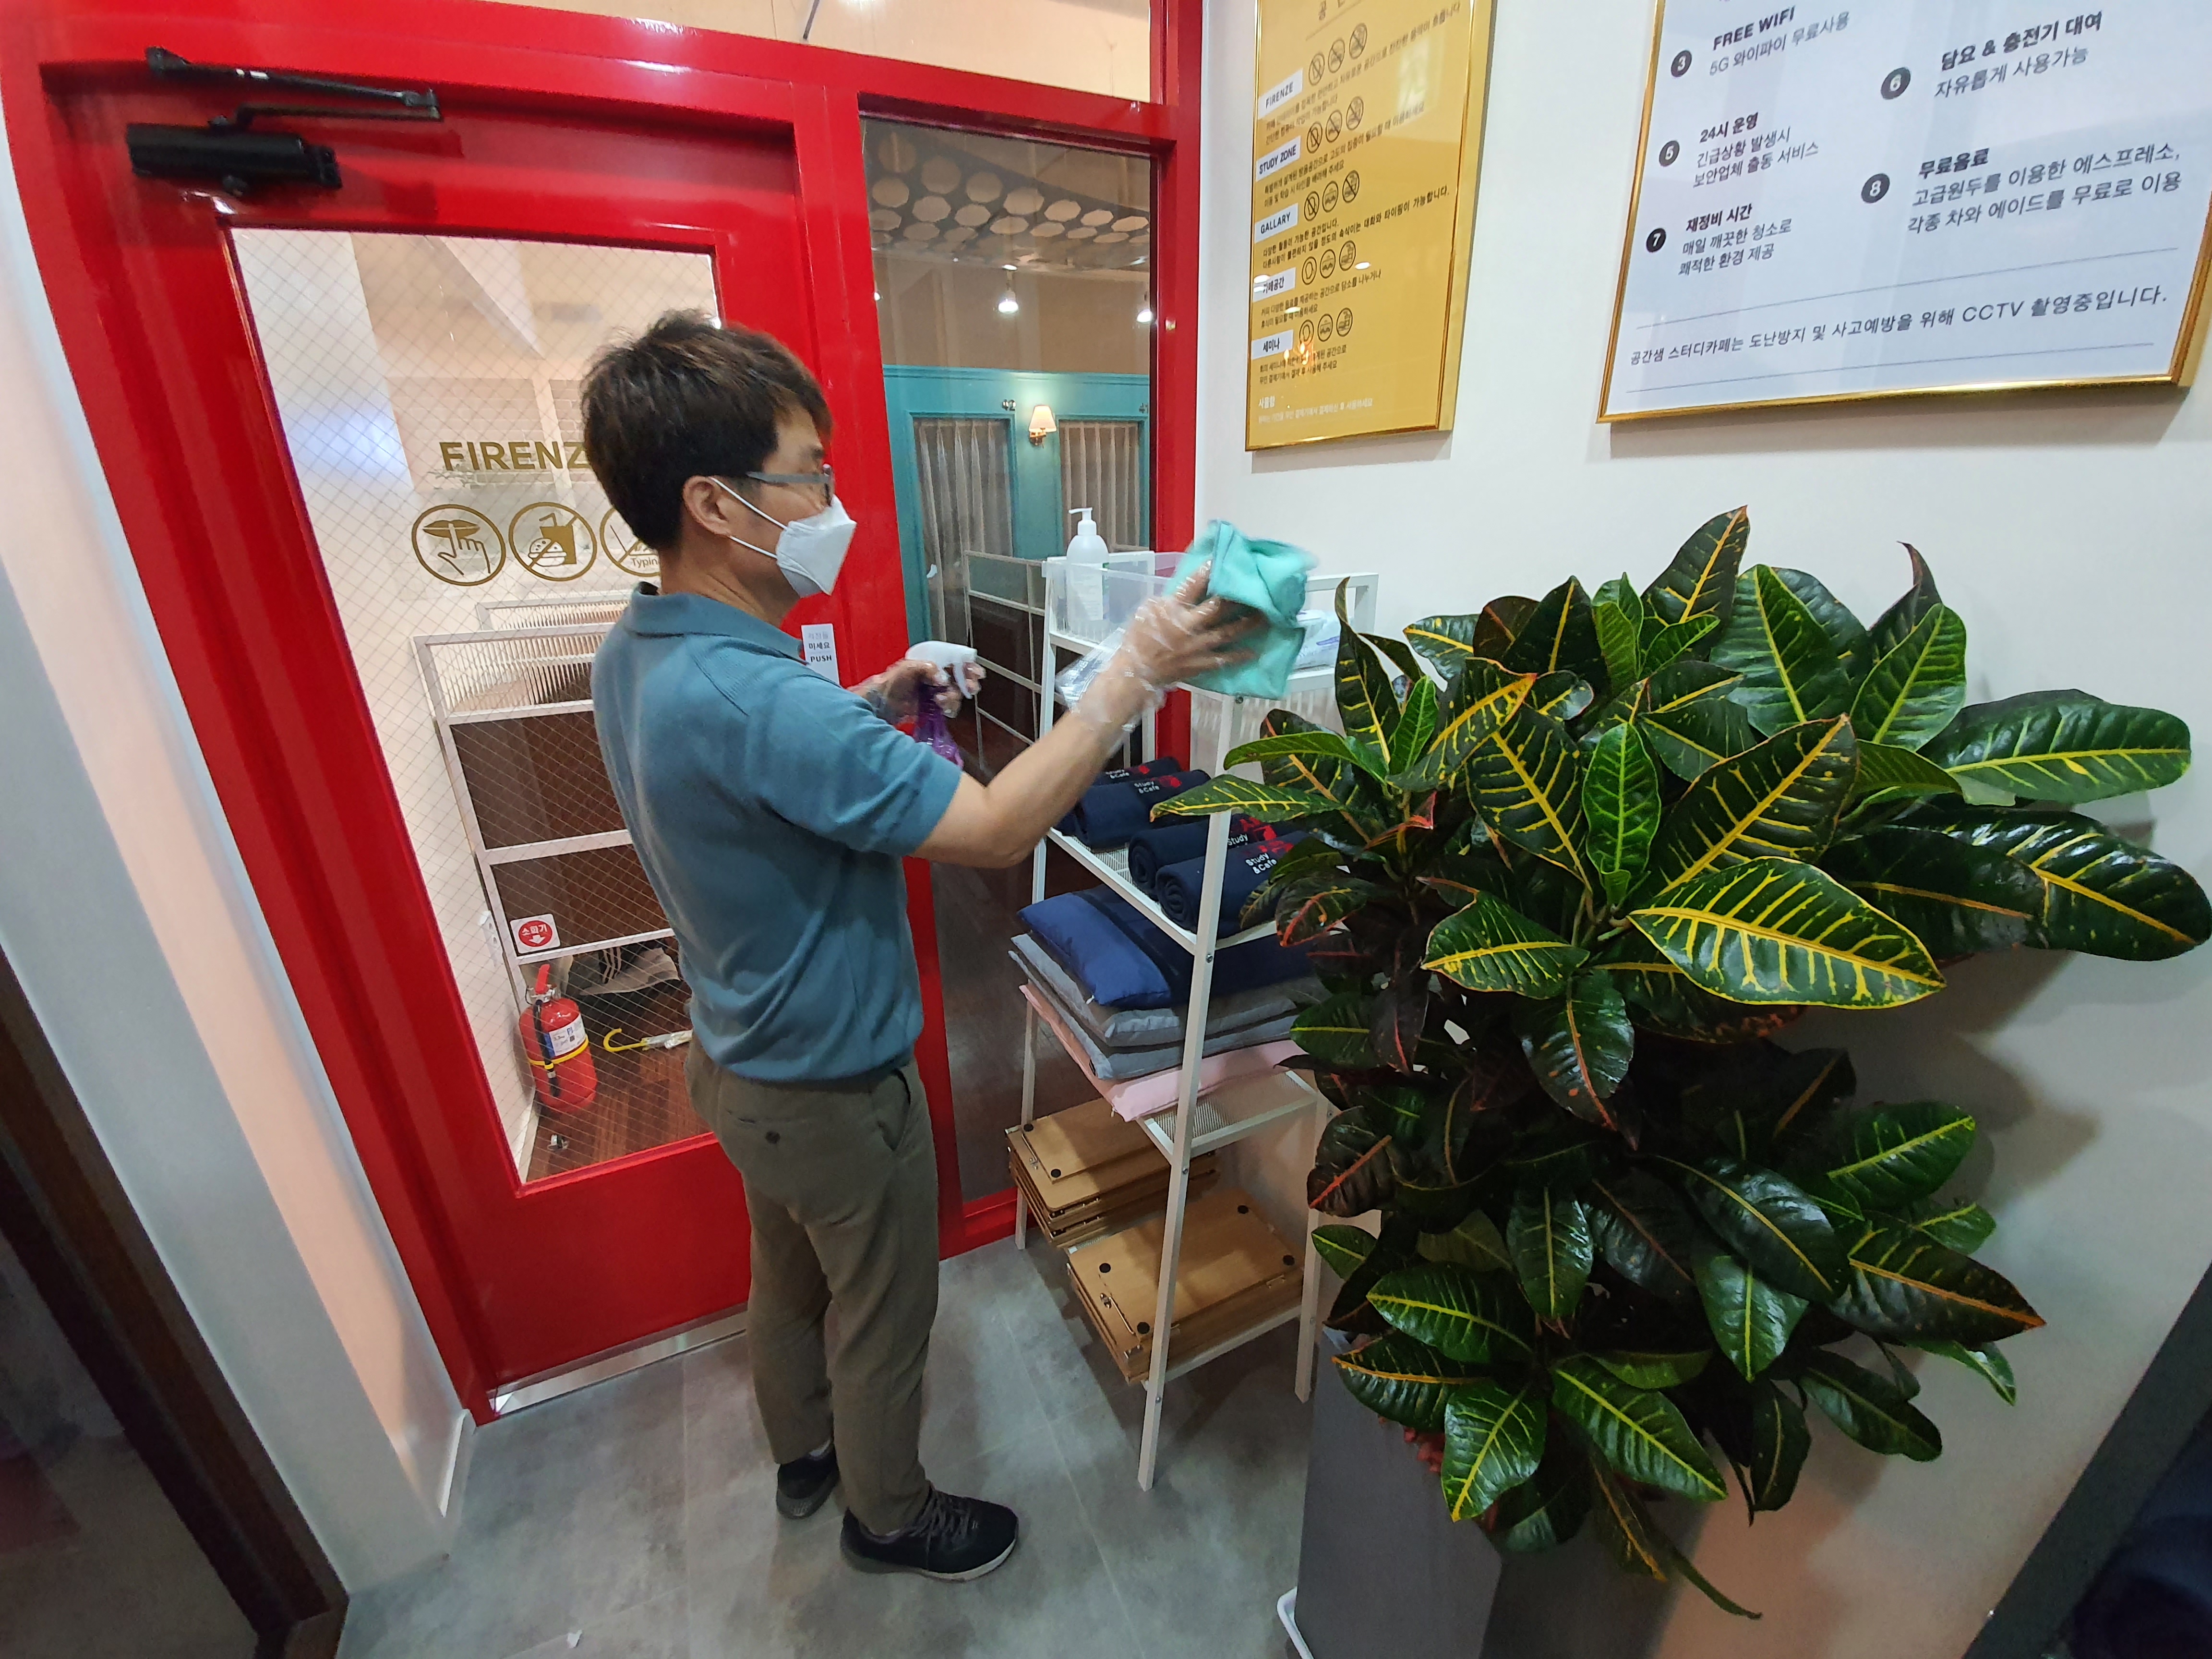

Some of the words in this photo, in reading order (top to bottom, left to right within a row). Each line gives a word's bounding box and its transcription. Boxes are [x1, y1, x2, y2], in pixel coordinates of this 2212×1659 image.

[1709, 56, 1729, 76] 5G
[1733, 34, 1787, 66] 와이파이
[1792, 11, 1850, 47] 무료사용
[1713, 22, 1754, 50] FREE
[1759, 5, 1796, 33] WIFI
[1941, 44, 1976, 72] 담요
[1982, 39, 1996, 57] &
[2003, 19, 2059, 54] 충전기
[2065, 10, 2103, 36] 대여
[1934, 63, 2008, 98] 자유롭게
[2012, 46, 2089, 77] 사용가능
[1266, 82, 1293, 108] FIRENZE
[1700, 121, 1729, 144] 24시
[1732, 112, 1758, 134] 운영
[1259, 155, 1278, 174] STUDY
[1280, 144, 1297, 163] ZONE
[1697, 139, 1746, 168] 긴급상황
[1752, 126, 1791, 153] 발생시
[1693, 160, 1743, 188] 보안업체
[1747, 152, 1773, 173] 출동
[1778, 142, 1819, 163] 서비스
[1912, 172, 2001, 207] 고급원두를
[2009, 159, 2066, 186] 이용한
[2073, 143, 2180, 175] 에스프레소,
[1919, 148, 1990, 180] 무료음료
[1364, 212, 1382, 228] 대화와
[1384, 200, 1410, 219] 타이핑이
[1413, 184, 1449, 208] 가능합니다.
[1686, 210, 1723, 232] 재정비
[1726, 203, 1752, 223] 시간
[1908, 212, 1941, 234] 각종
[1945, 204, 1982, 227] 차와
[1988, 189, 2065, 219] 에이드를
[2072, 178, 2133, 205] 무료로
[2141, 171, 2182, 193] 이용
[1261, 212, 1290, 234] GALLARY
[1683, 237, 1707, 255] 매일
[1710, 228, 1748, 249] 깨끗한
[1752, 218, 1792, 240] 청소로
[1678, 255, 1715, 276] 쾌적한
[1719, 249, 1744, 269] 환경
[1747, 243, 1775, 261] 제공
[1358, 269, 1381, 284] 나누거나
[1631, 347, 1664, 366] 공간샘
[1668, 337, 1743, 360] 스터디카페는
[1749, 327, 1806, 349] 도난방지
[1812, 325, 1825, 341] 및
[1832, 313, 1913, 337] 사고예방을
[1920, 308, 1955, 328] 위해
[1962, 300, 2025, 322] CCTV
[2031, 285, 2167, 317] 촬영중입니다.
[1263, 337, 1280, 352] 세미나
[1002, 399, 1016, 411] 42
[630, 557, 660, 568] Typin
[808, 642, 830, 650] 미세요
[1227, 834, 1248, 846] Study
[1245, 853, 1269, 866] Study
[521, 924, 547, 936] 소화기
